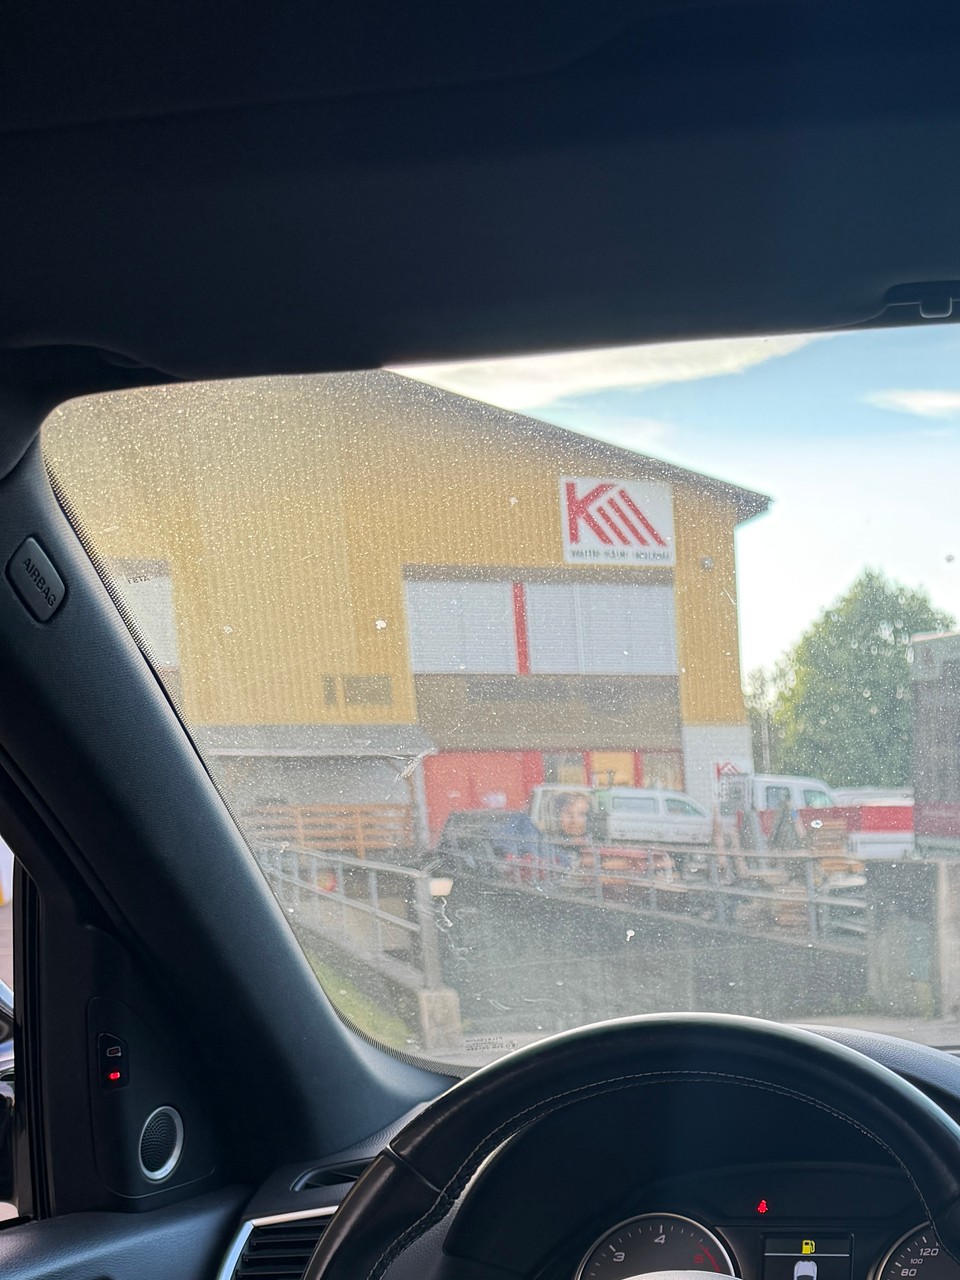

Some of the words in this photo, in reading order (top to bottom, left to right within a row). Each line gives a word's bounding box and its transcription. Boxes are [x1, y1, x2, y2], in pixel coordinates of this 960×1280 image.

[22, 557, 58, 609] AIRBAG
[654, 1234, 666, 1244] 4
[613, 1252, 626, 1262] 3
[919, 1248, 939, 1256] 120
[900, 1268, 917, 1277] 80
